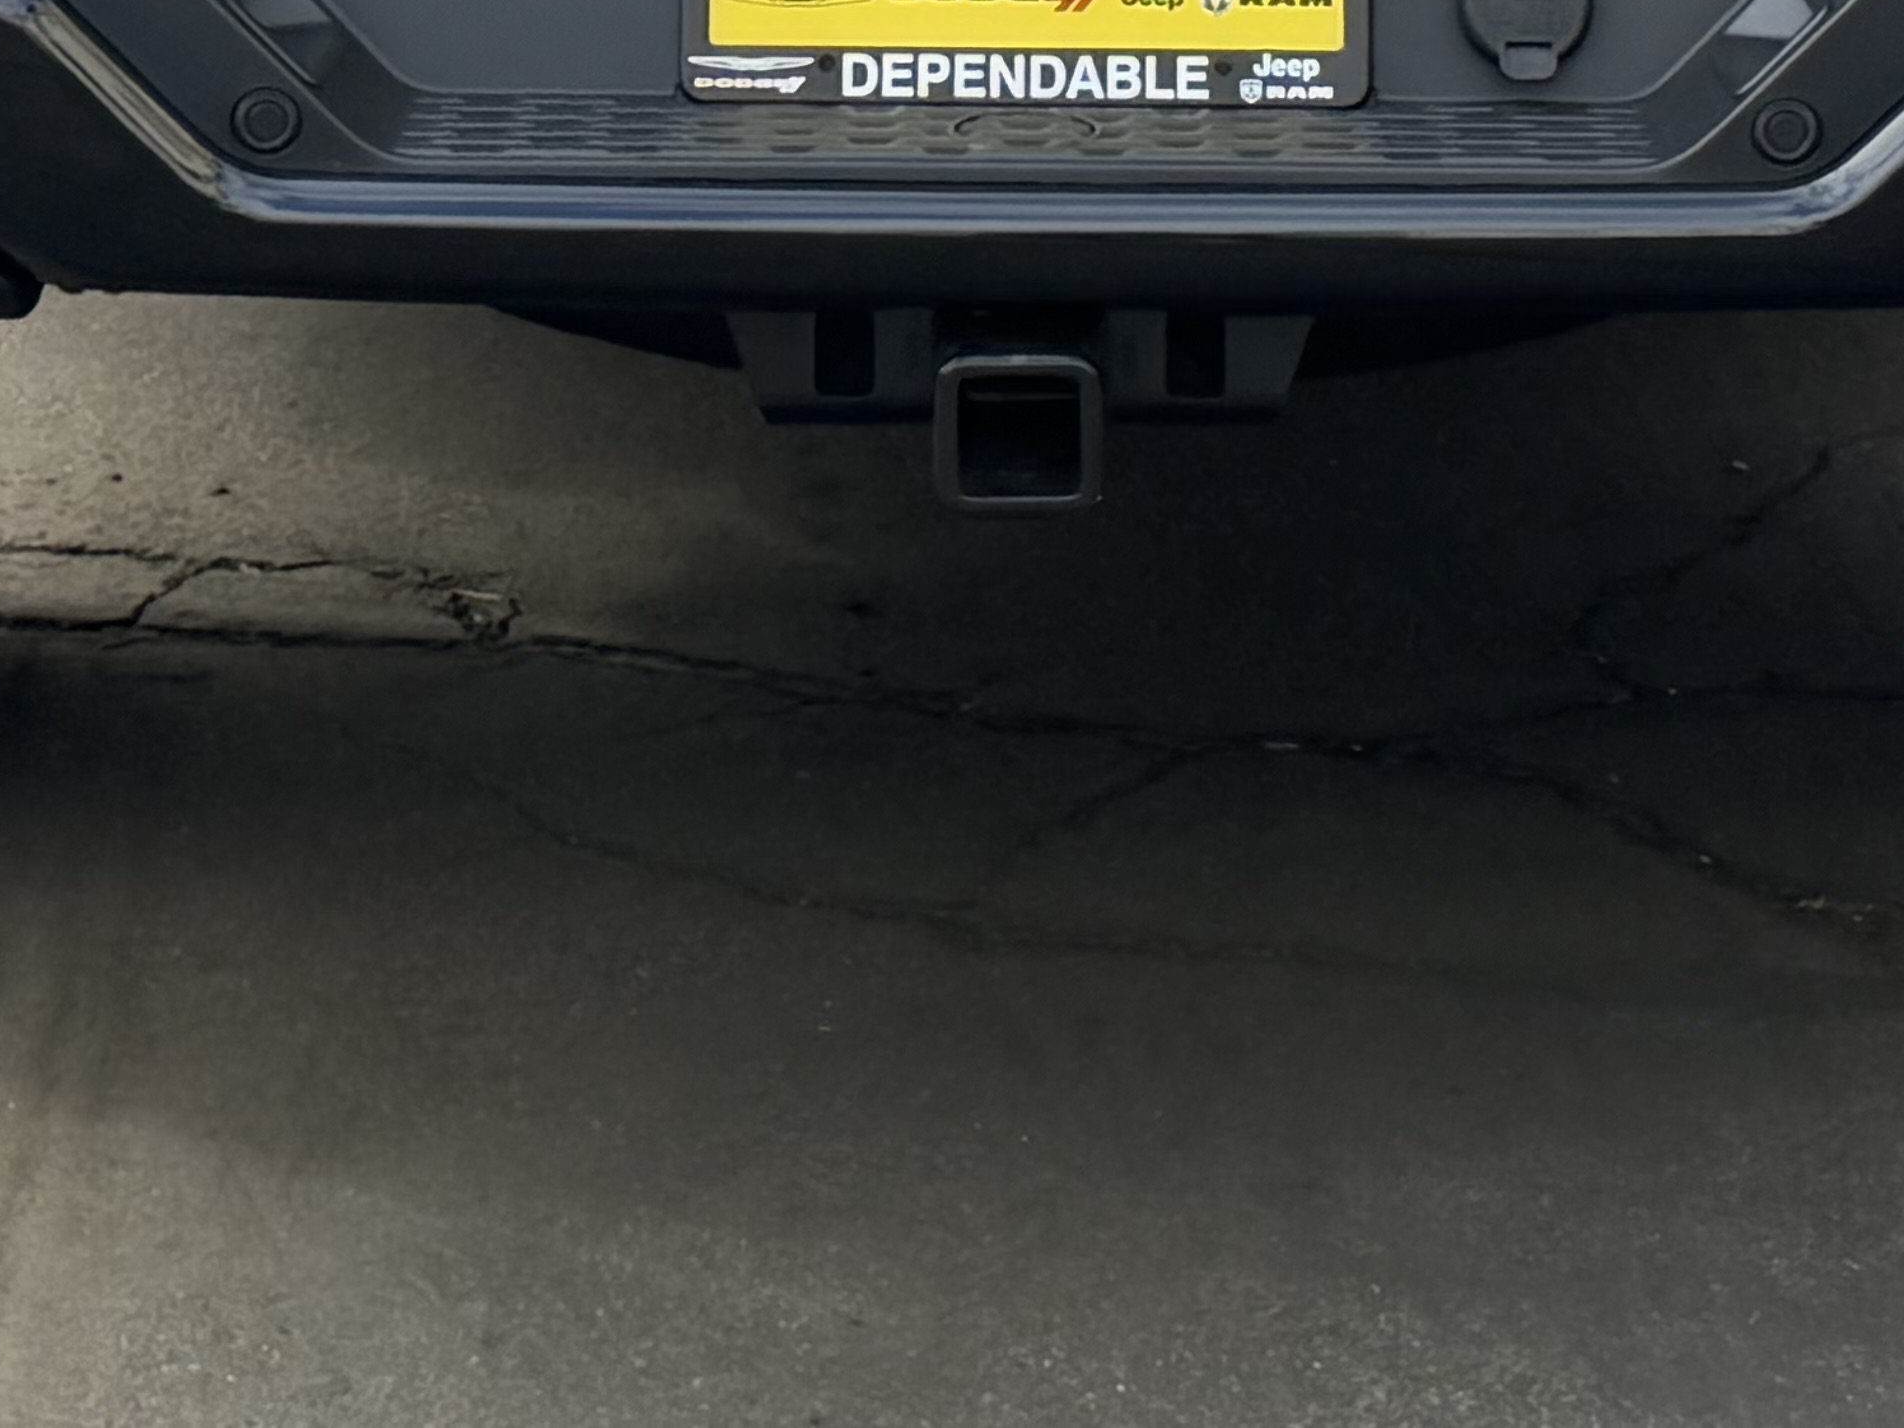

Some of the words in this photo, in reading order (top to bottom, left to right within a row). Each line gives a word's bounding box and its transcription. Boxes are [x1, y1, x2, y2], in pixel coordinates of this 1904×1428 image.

[841, 52, 1210, 101] DEPENDABLE
[1252, 52, 1321, 82] Jeep
[1265, 85, 1335, 100] RAM
